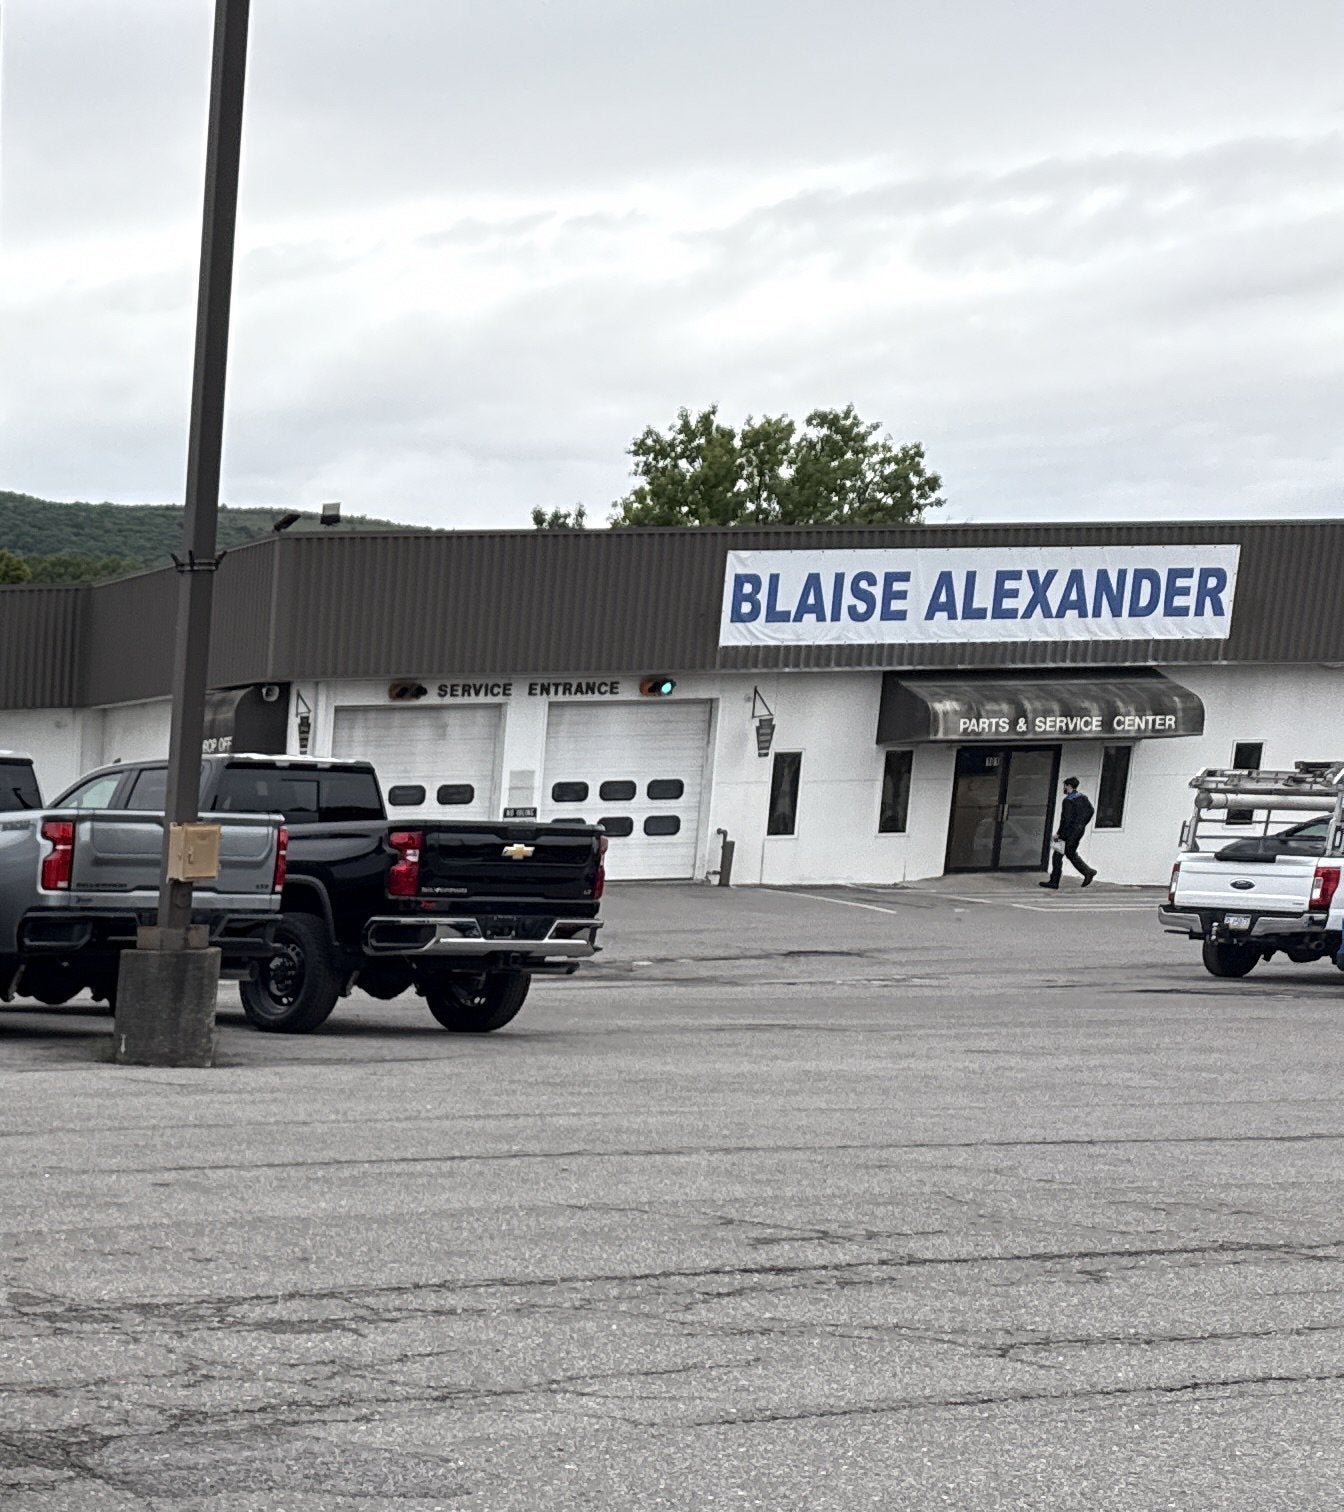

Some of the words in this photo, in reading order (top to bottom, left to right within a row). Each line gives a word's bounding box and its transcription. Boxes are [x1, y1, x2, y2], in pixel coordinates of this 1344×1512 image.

[729, 570, 911, 624] BLAISE
[924, 567, 1228, 621] ALEXANDER
[437, 683, 512, 698] SERVICE
[528, 681, 620, 697] ENTRANCE
[959, 718, 1010, 733] PARTS
[1016, 717, 1027, 732] &
[1035, 716, 1103, 732] SERVICE
[1113, 715, 1176, 731] CENTER
